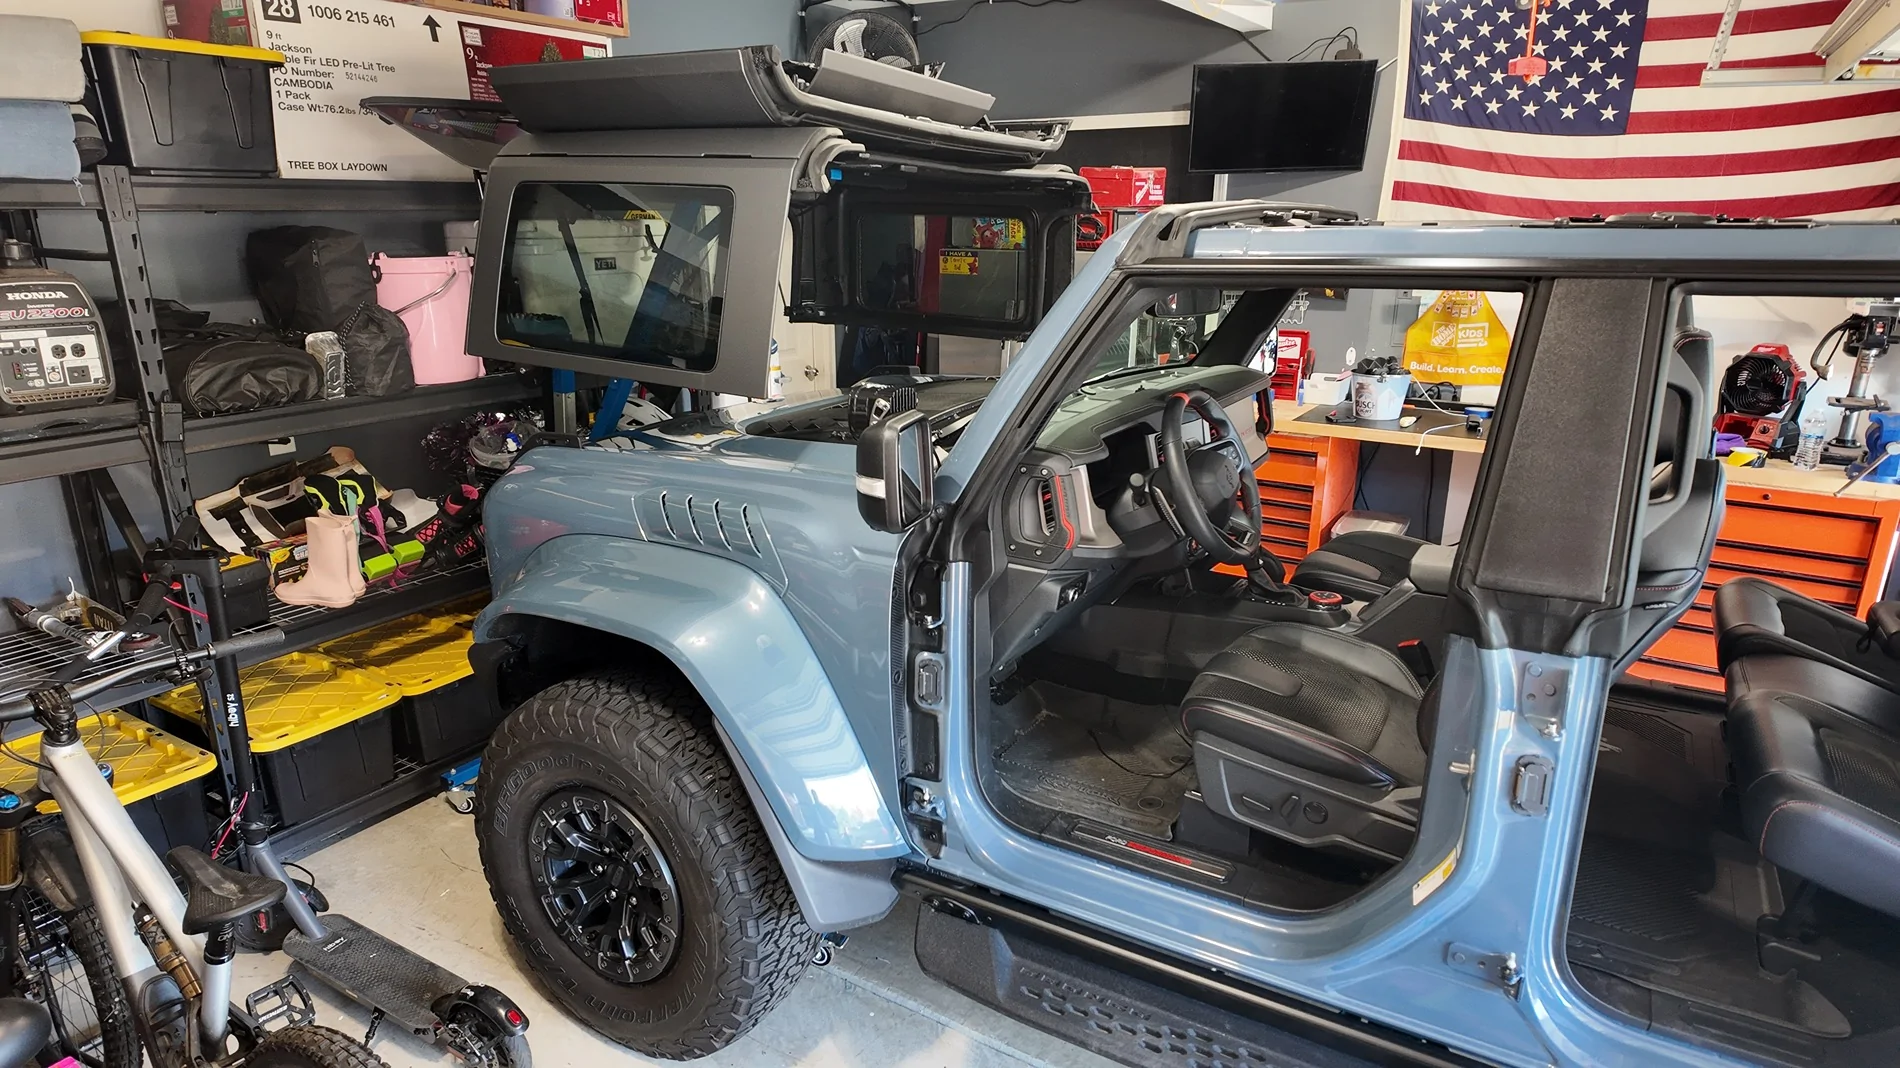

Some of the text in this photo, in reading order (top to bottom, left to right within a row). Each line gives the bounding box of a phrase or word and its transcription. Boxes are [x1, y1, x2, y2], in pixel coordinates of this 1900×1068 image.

[267, 0, 295, 18] 28
[308, 5, 395, 28] 1006 215 461
[266, 30, 273, 39] 9
[268, 42, 312, 54] Jackson
[285, 54, 395, 73] ble Fir LED Pre-Lit Tree
[272, 67, 378, 83] PO Number: 52144246
[274, 78, 333, 90] CAMBODIA
[275, 90, 311, 100] 1 Pack
[278, 102, 305, 112] Case
[345, 107, 356, 115] lbs
[287, 161, 388, 172] TREE BOX LAYDOWN
[595, 260, 616, 268] YETI
[6, 291, 69, 301] HONDA
[1459, 329, 1483, 338] KIDS
[1410, 362, 1504, 375] Build. Learn. Create.
[93, 613, 114, 631] TITAN
[227, 702, 239, 727] hiboy
